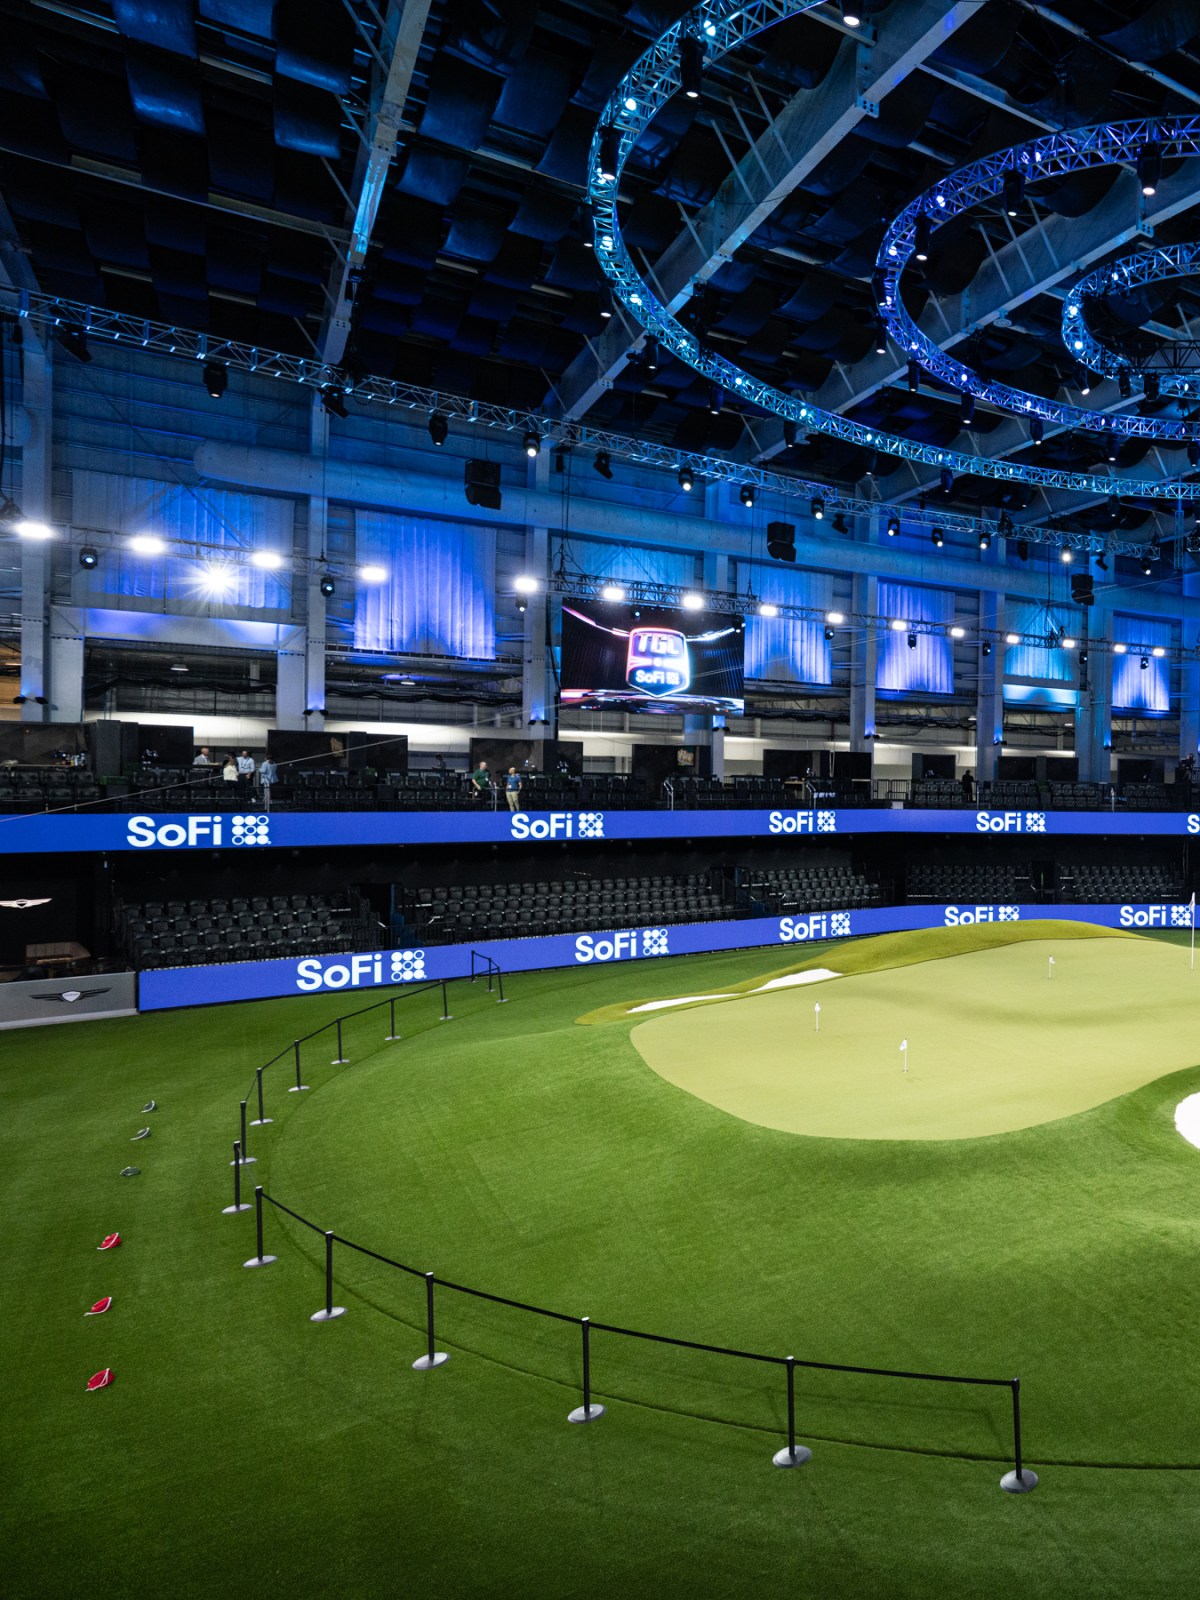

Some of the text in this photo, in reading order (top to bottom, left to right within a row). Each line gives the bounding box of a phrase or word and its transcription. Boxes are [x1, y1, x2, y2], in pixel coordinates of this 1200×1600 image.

[637, 632, 680, 655] TGL
[635, 669, 665, 685] SoFi
[126, 815, 222, 848] SoFi
[510, 813, 573, 839] SoFi
[769, 811, 813, 833] SoFi
[976, 811, 1022, 832] SoFi
[945, 906, 994, 927] SoFi
[1119, 905, 1167, 926] SoFi
[779, 916, 827, 942] SoFi
[574, 929, 637, 963] SoFi
[295, 953, 382, 991] SoFi
